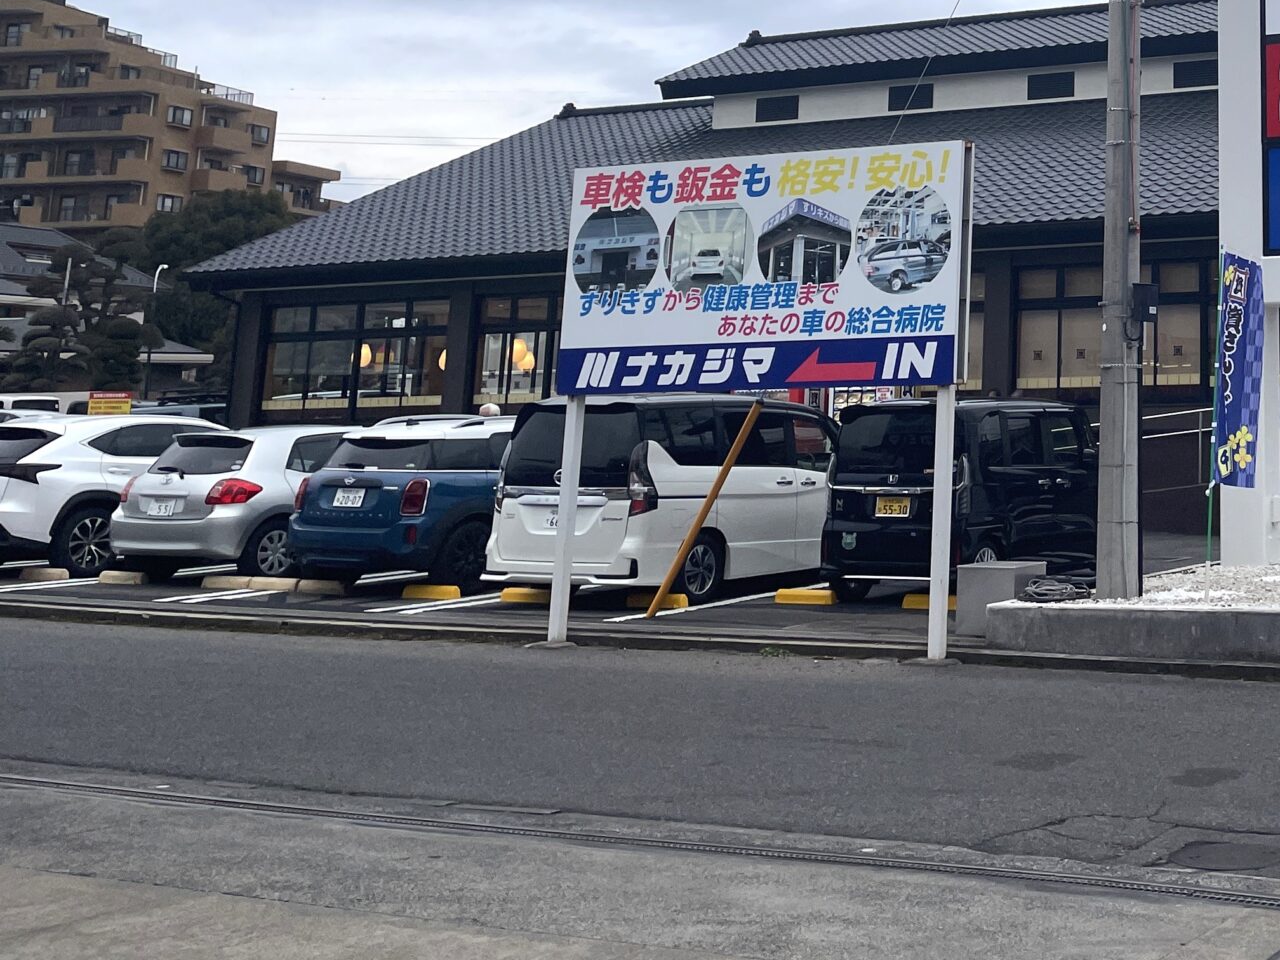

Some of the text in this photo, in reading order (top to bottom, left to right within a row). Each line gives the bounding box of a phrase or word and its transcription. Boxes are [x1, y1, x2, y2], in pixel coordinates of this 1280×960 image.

[579, 281, 839, 317] すりきずから健康管理まで
[717, 303, 946, 337] あなたの車の総合病院
[621, 346, 776, 387] ナカジマ
[881, 341, 938, 380] IN
